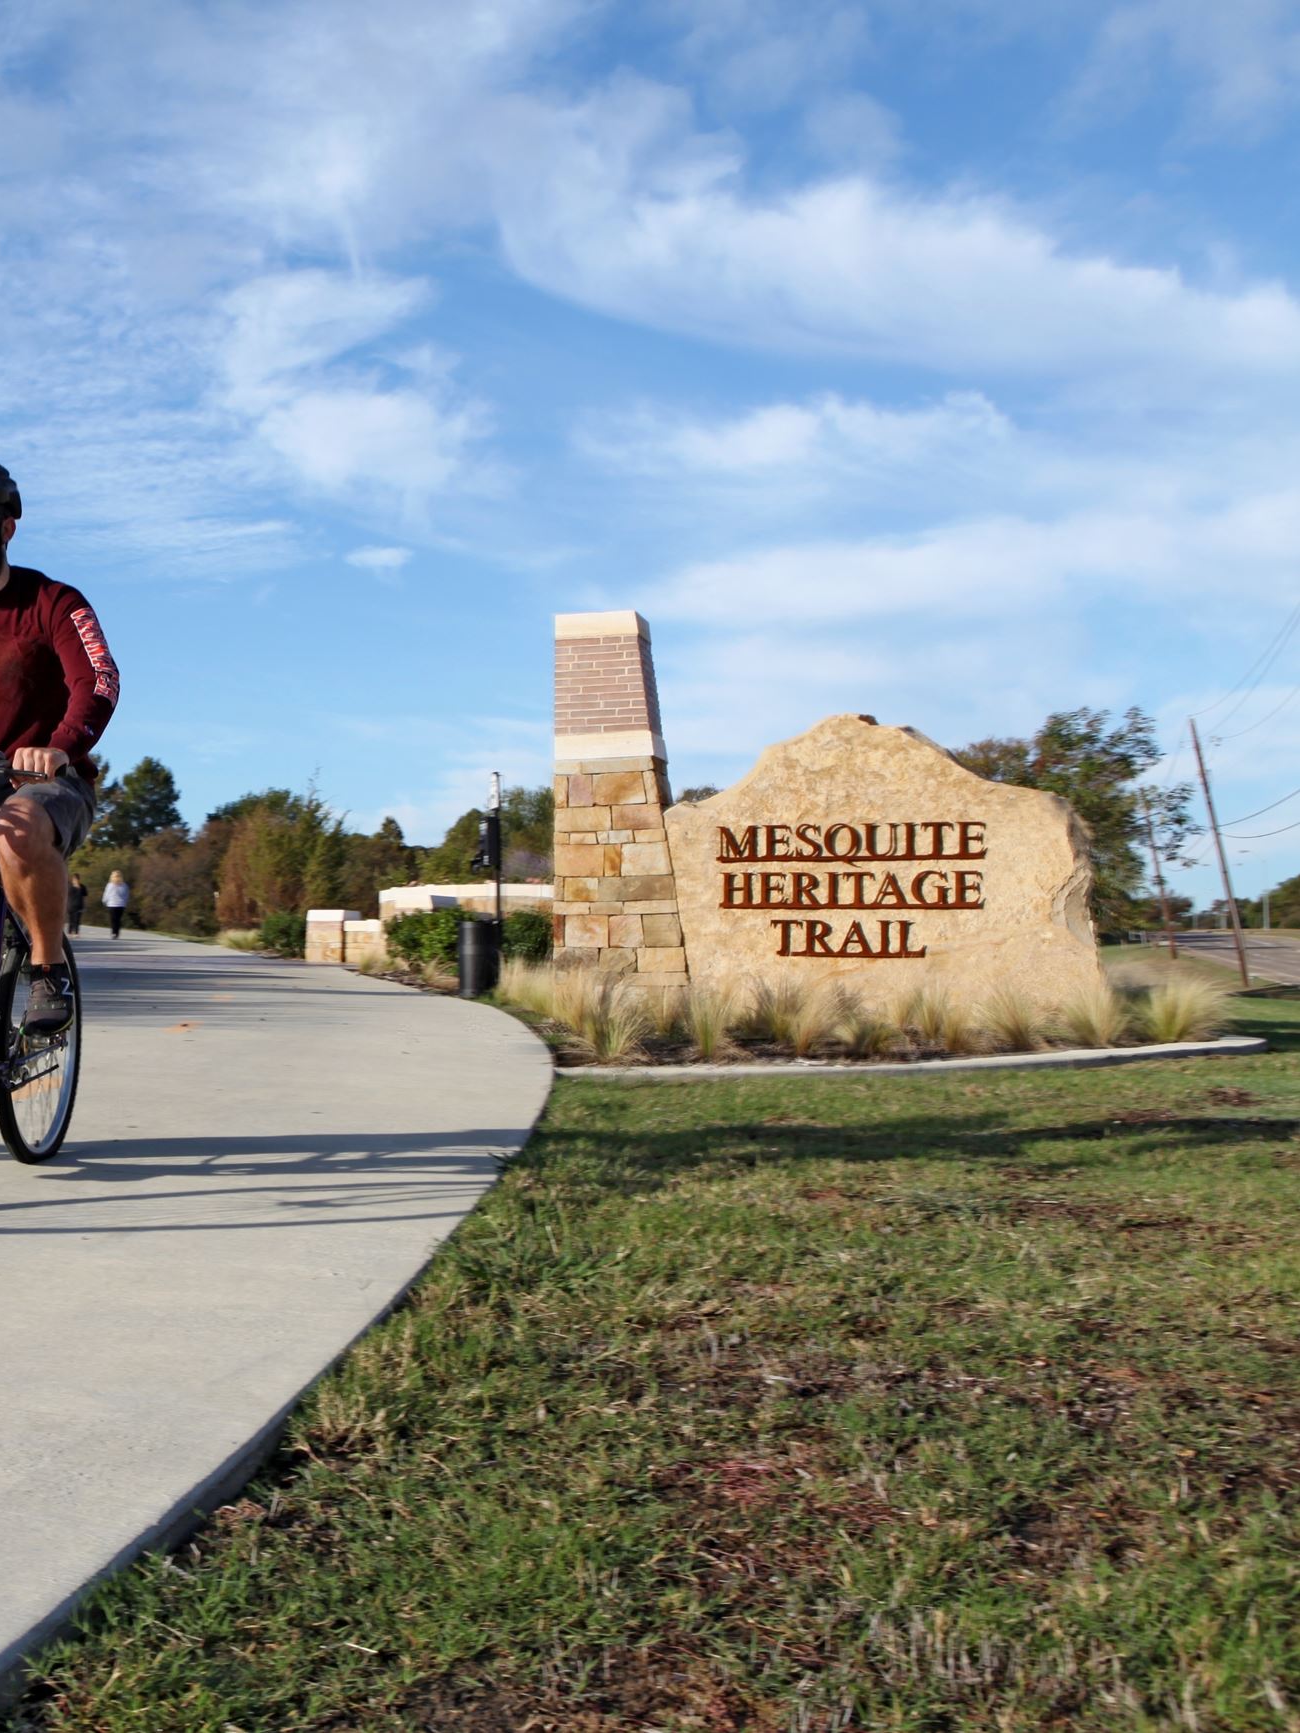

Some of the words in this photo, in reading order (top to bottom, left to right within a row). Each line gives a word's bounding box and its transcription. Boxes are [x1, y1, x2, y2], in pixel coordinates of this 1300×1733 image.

[716, 821, 988, 867] MESQUITE
[718, 870, 986, 910] HERITAGE
[770, 919, 928, 958] TRAIL
